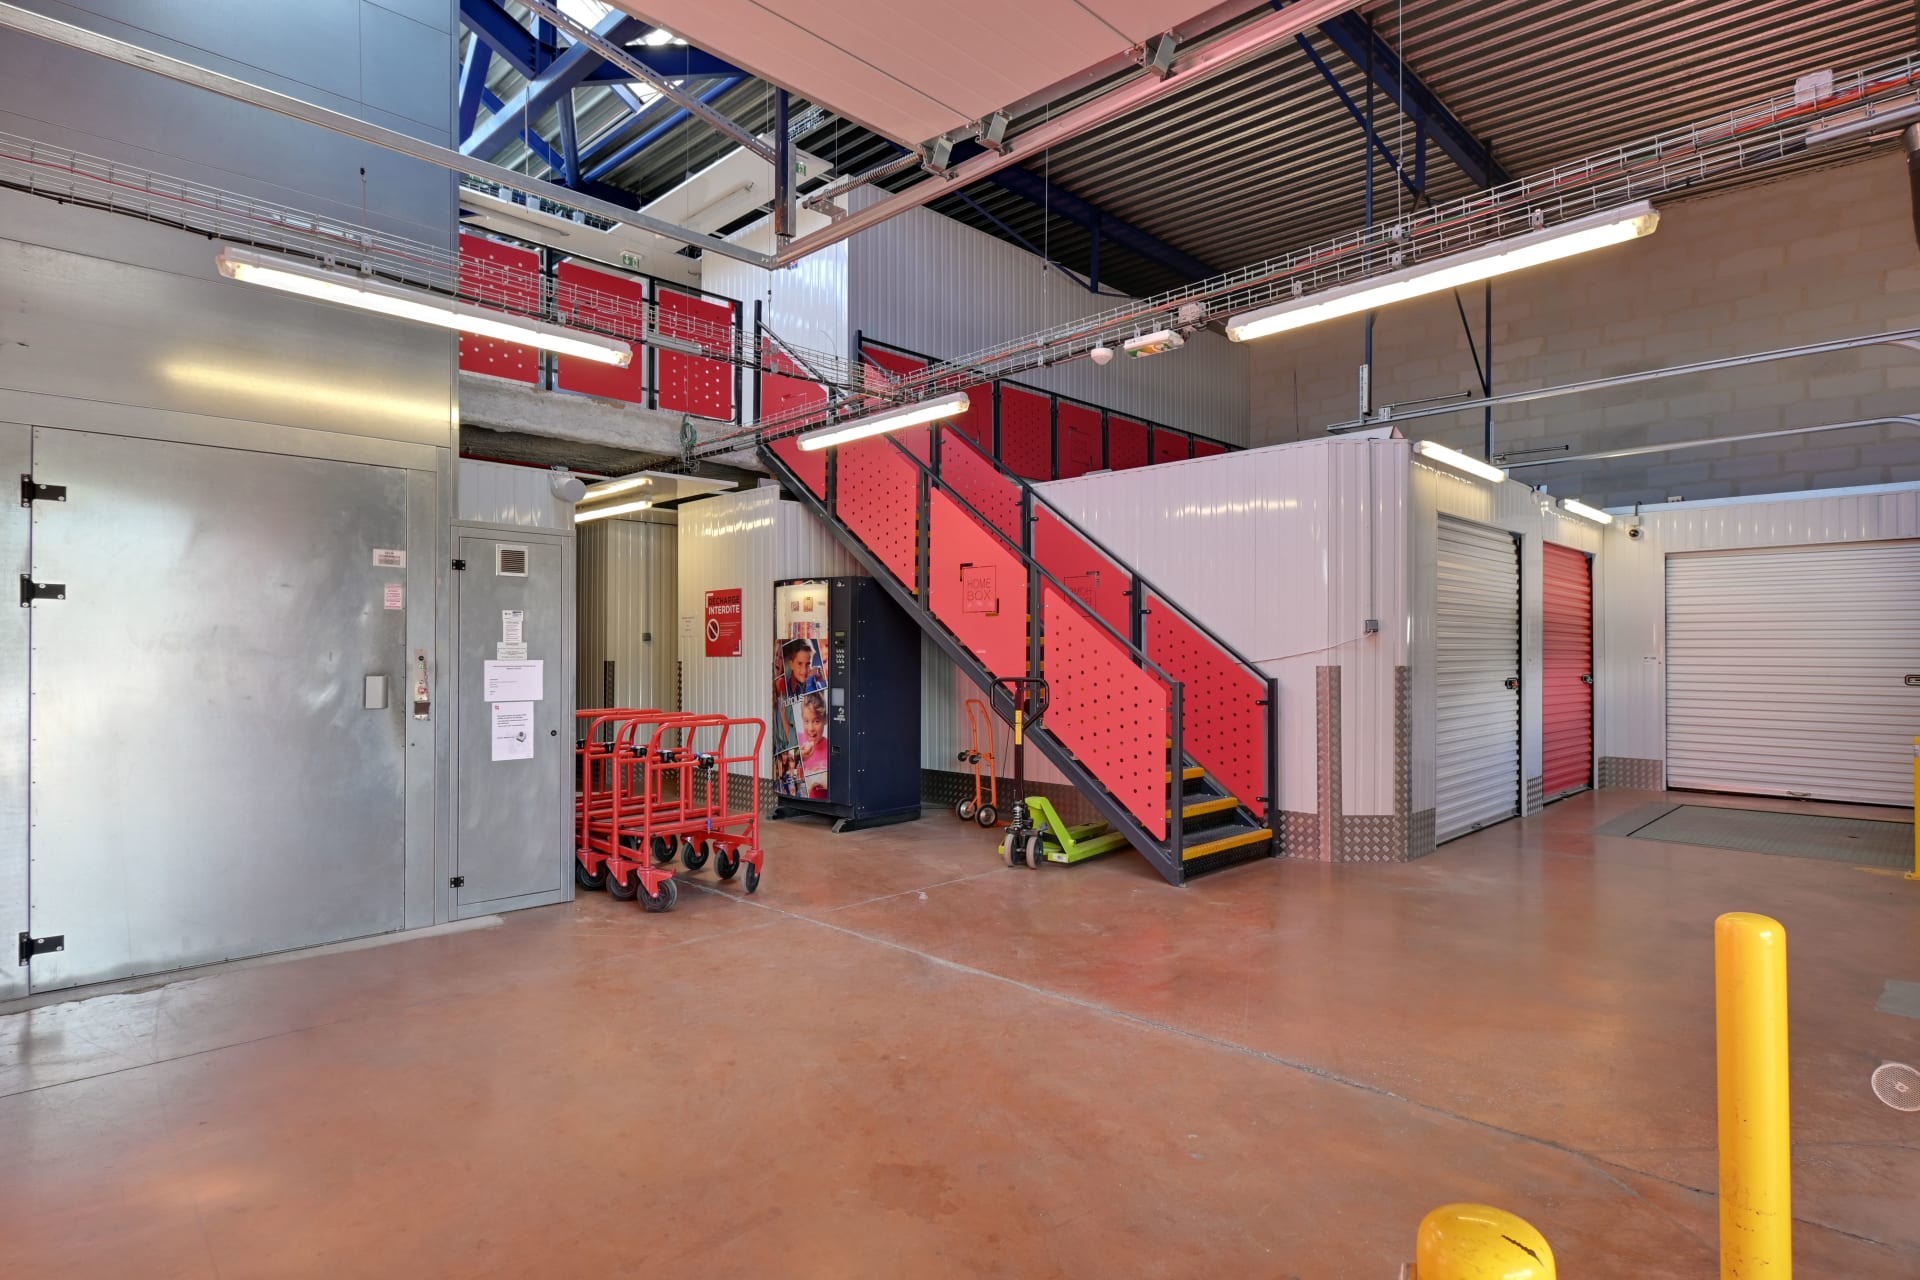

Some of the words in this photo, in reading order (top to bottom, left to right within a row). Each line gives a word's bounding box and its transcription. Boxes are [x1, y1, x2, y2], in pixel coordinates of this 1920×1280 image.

[967, 578, 991, 589] HOME
[967, 590, 991, 601] BOX
[708, 604, 740, 615] INTERDITE
